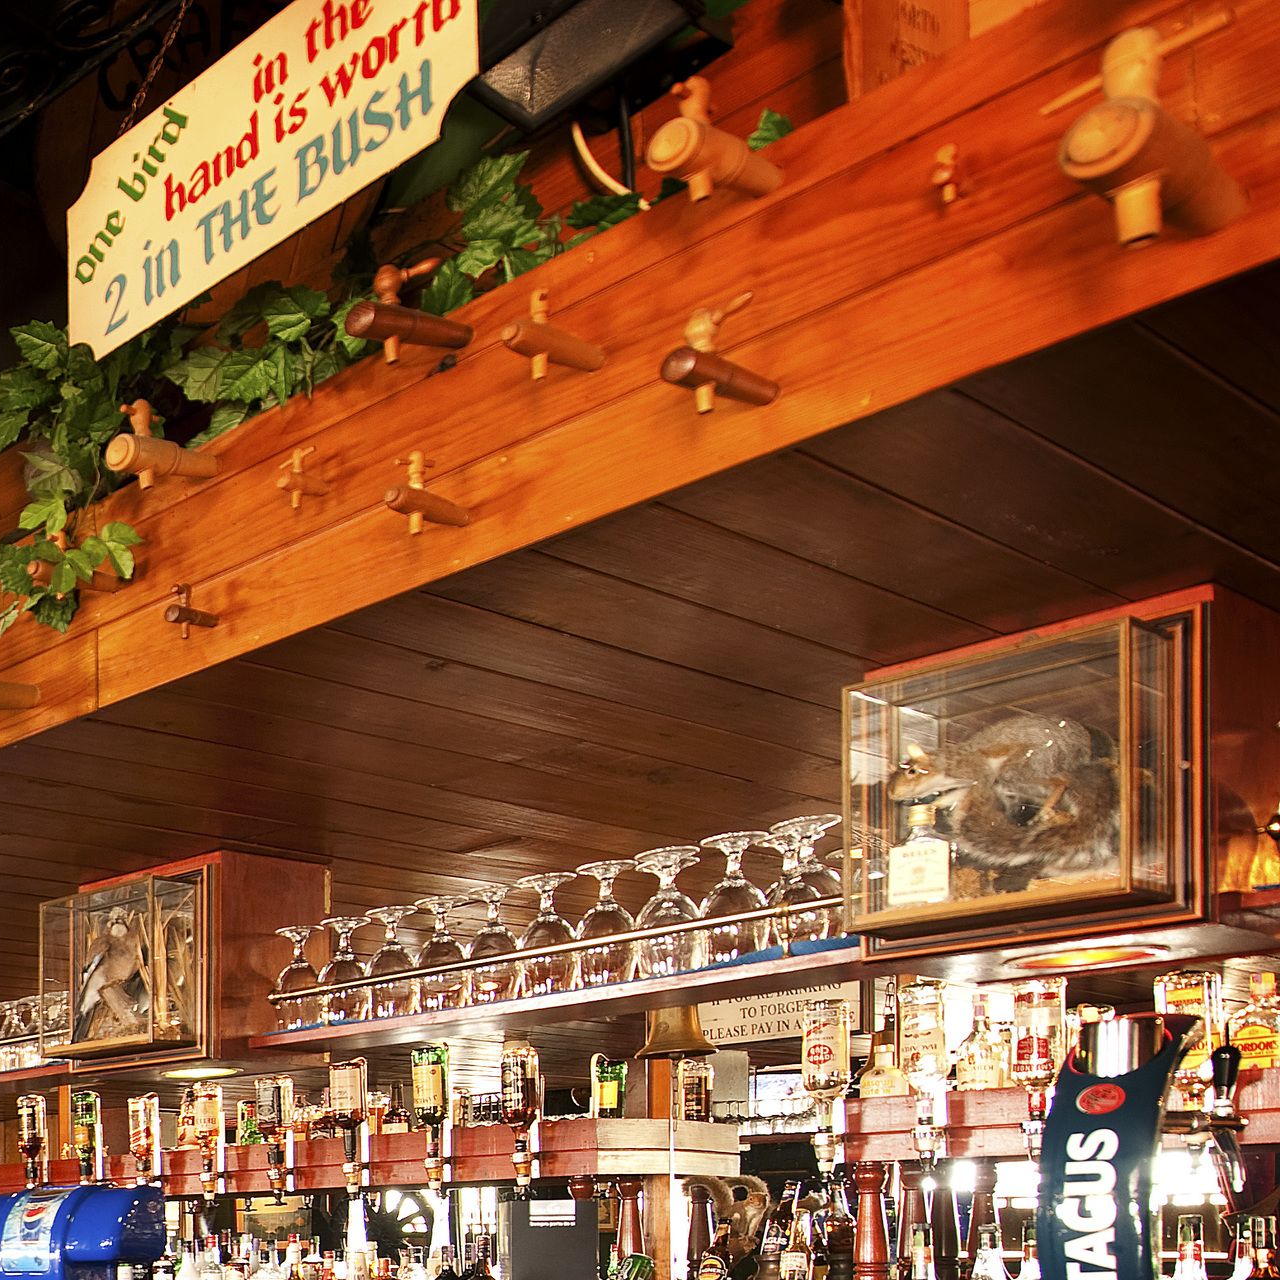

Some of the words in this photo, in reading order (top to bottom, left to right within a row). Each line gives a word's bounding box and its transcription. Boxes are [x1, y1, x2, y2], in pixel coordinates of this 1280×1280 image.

[253, 53, 288, 103] in
[305, 0, 375, 63] the
[164, 110, 259, 222] hand
[275, 86, 311, 143] is
[320, 0, 462, 108] worth
[74, 209, 126, 284] one
[117, 102, 190, 202] bird
[104, 273, 129, 336] 2
[142, 238, 180, 307] in
[196, 168, 280, 265] THE
[294, 58, 433, 204] BUSH
[702, 1025, 748, 1040] PLEASE
[751, 1023, 774, 1035] PAY
[777, 1020, 791, 1031] IN
[740, 1007, 757, 1019] TO
[761, 1000, 806, 1015] FORGE
[1012, 1059, 1054, 1073] SMINOFF
[763, 1237, 788, 1246] AGUS
